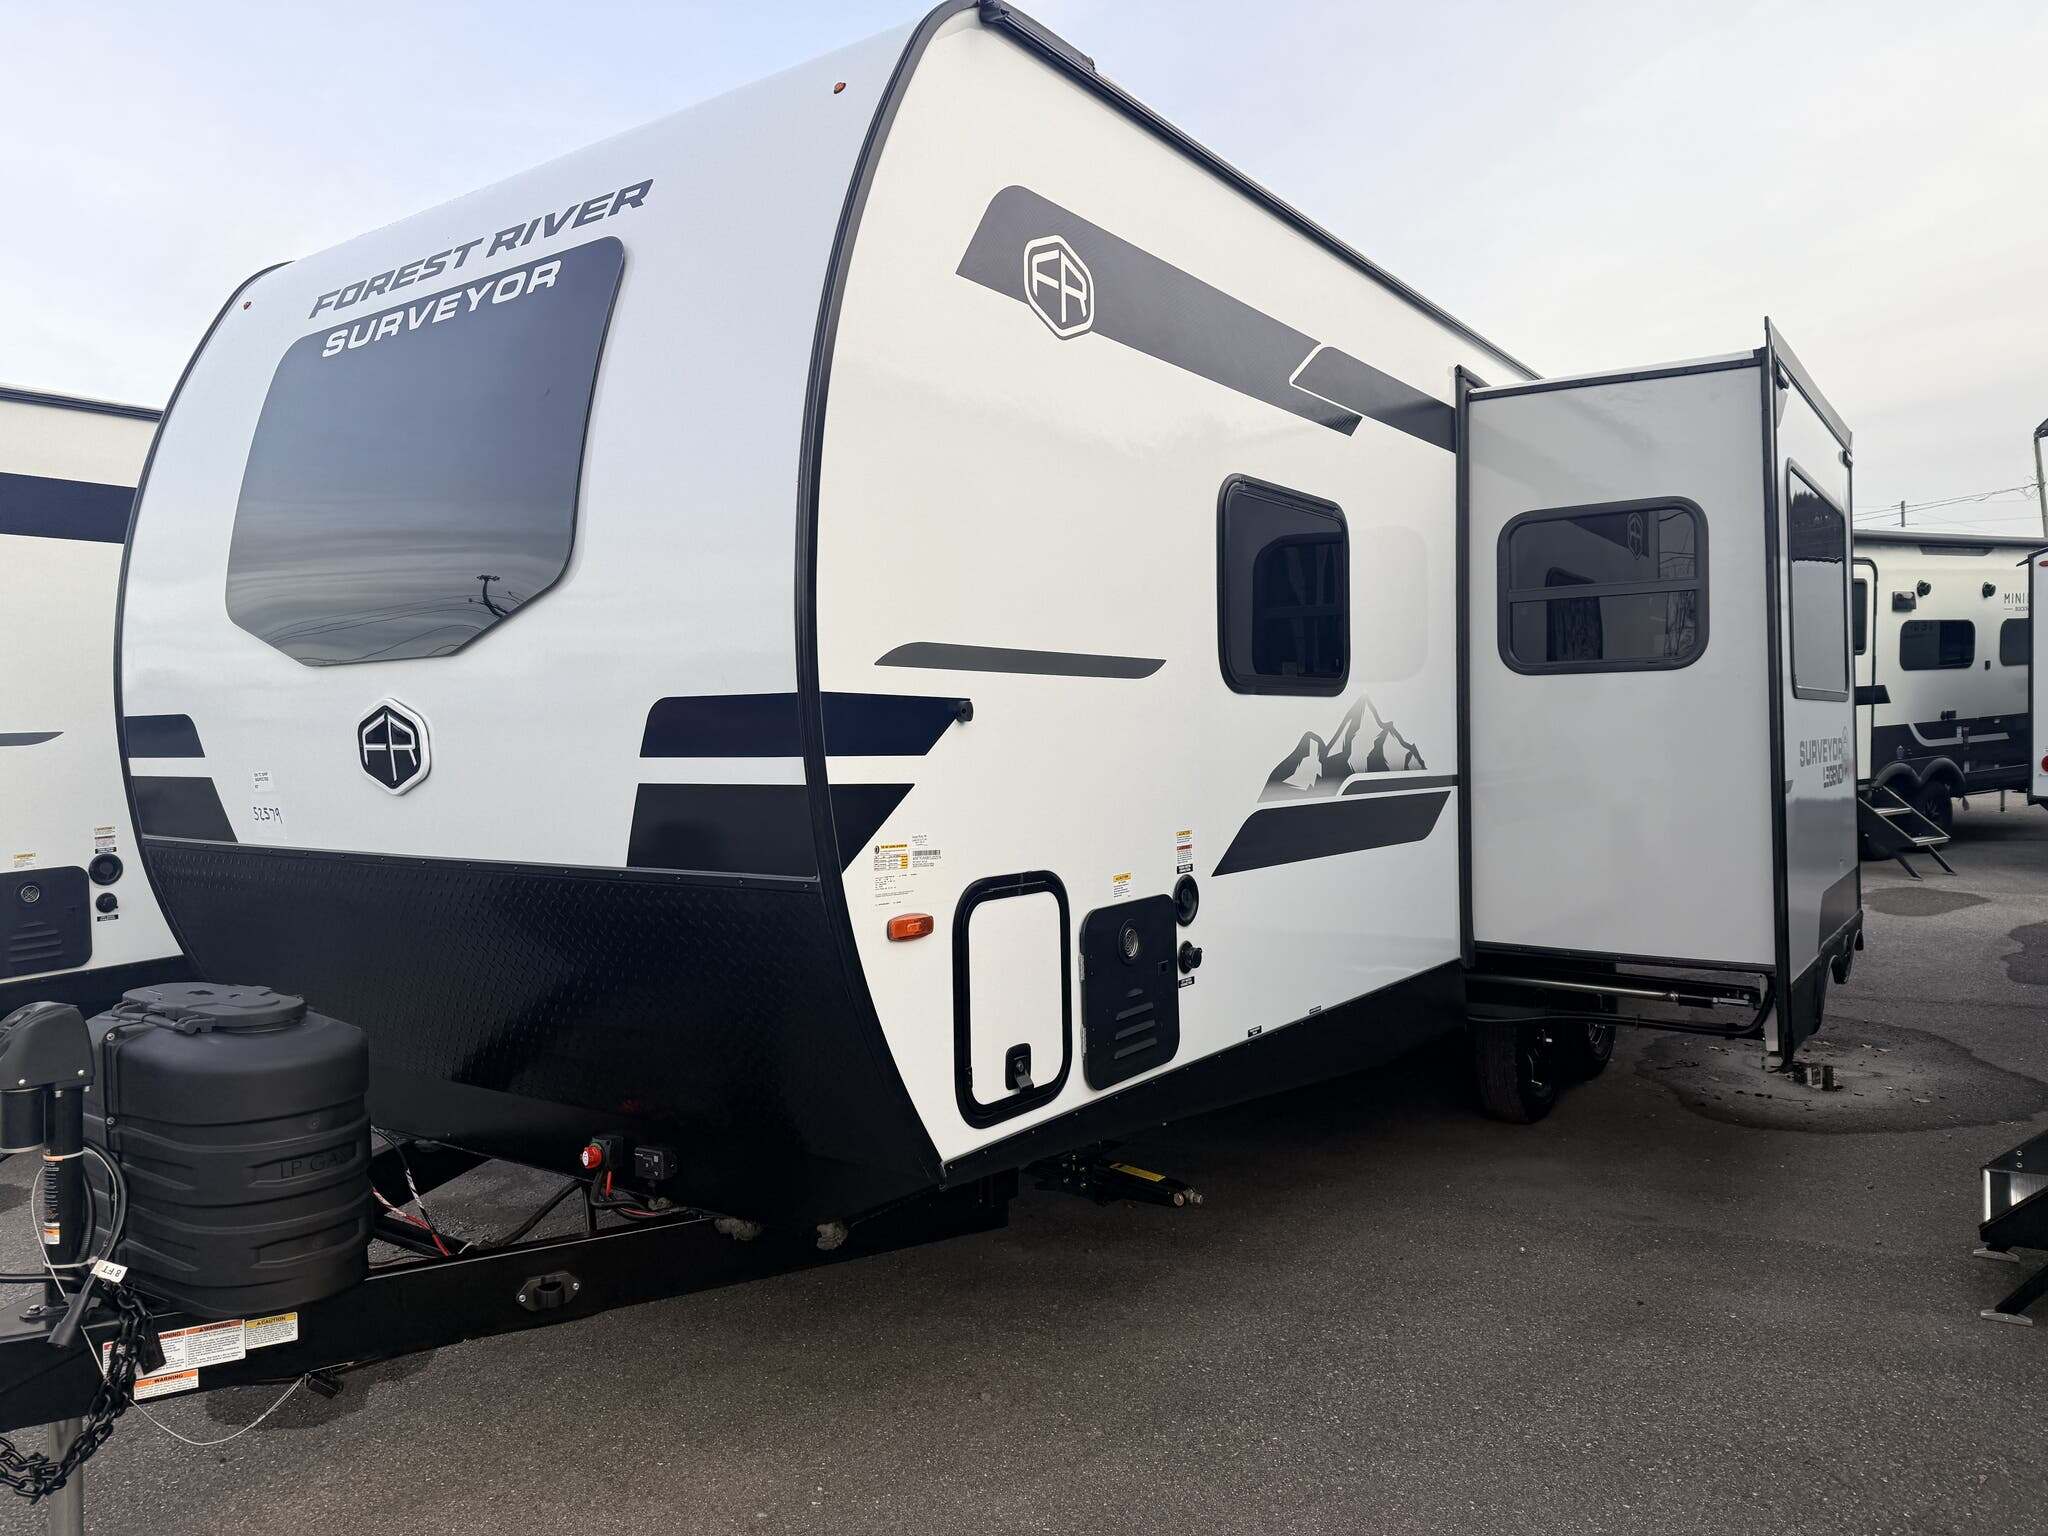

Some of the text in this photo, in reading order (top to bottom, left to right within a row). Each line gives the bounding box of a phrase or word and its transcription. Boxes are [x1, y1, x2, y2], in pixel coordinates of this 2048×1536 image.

[308, 178, 654, 320] FOREST RIVER
[322, 260, 562, 358] SURVEYOR
[2004, 592, 2025, 604] MINI
[1799, 737, 1843, 767] SURVEYOR
[280, 1160, 302, 1179] LP
[154, 1373, 184, 1383] WARNING
